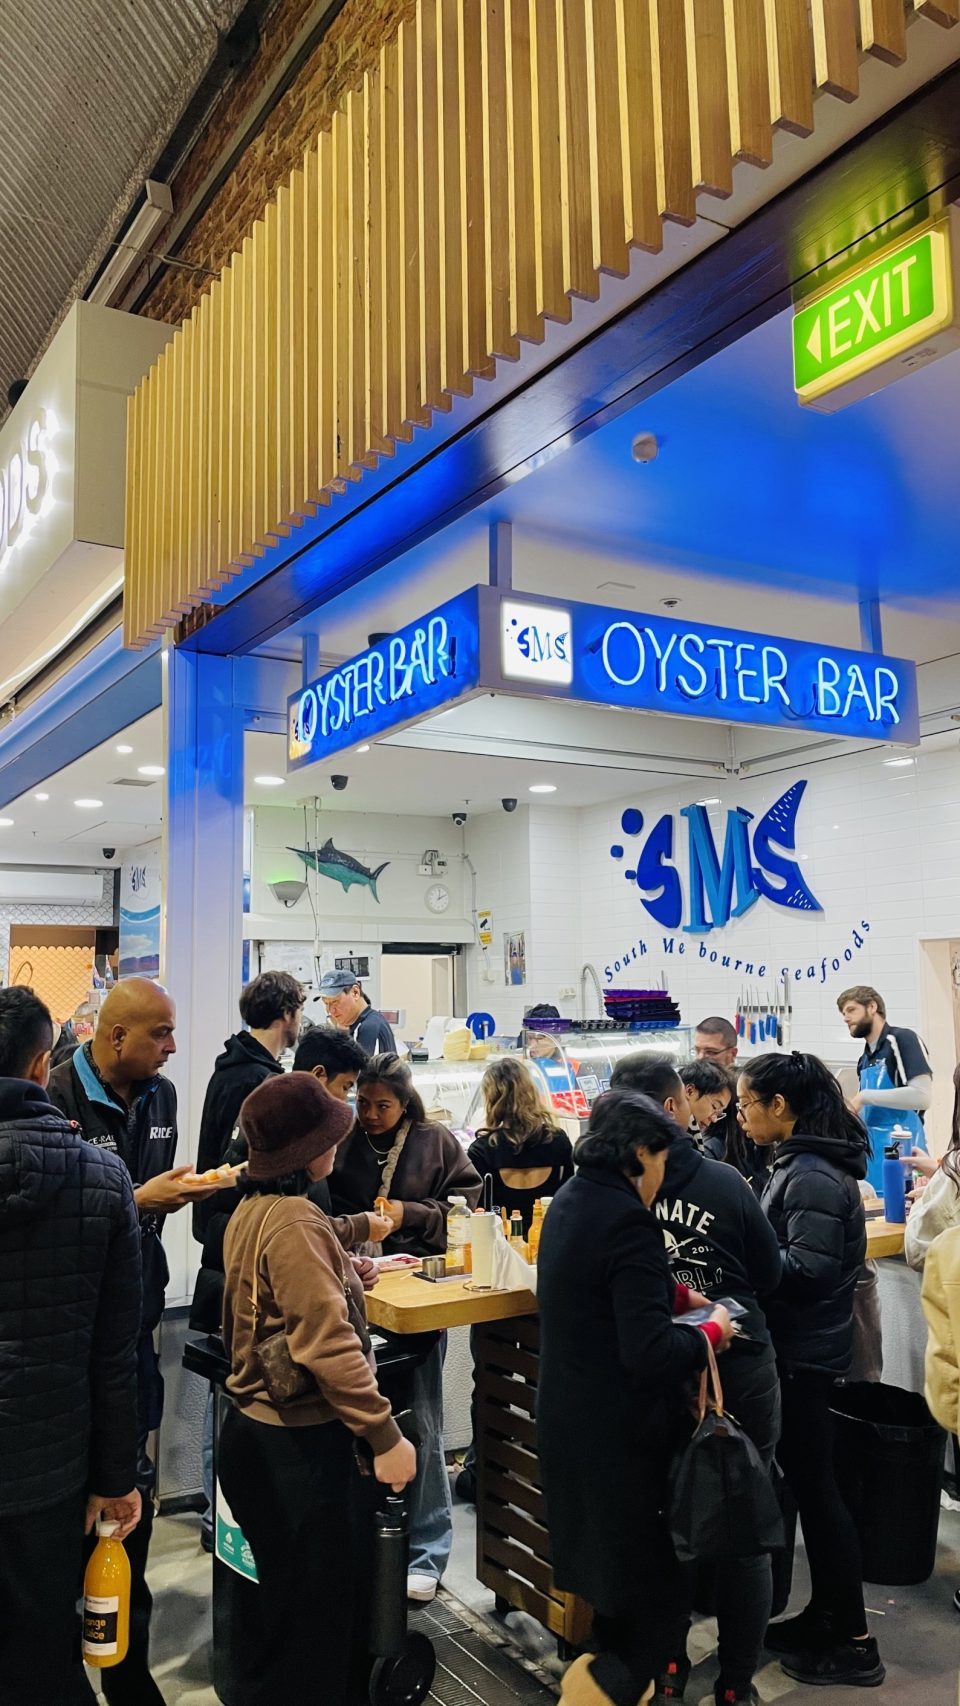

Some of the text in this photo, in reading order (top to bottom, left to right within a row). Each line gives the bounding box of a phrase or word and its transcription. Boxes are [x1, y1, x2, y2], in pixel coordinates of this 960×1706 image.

[828, 255, 917, 359] EXIT
[516, 626, 571, 664] SMS
[602, 621, 900, 723] OYSTER BAR
[298, 616, 449, 744] OYSTER BAR
[637, 780, 824, 933] SMS
[604, 940, 647, 983] South
[780, 919, 870, 984] Seafoods
[149, 1126, 173, 1140] RICE
[655, 1198, 715, 1235] NATE
[692, 1245, 714, 1255] 201
